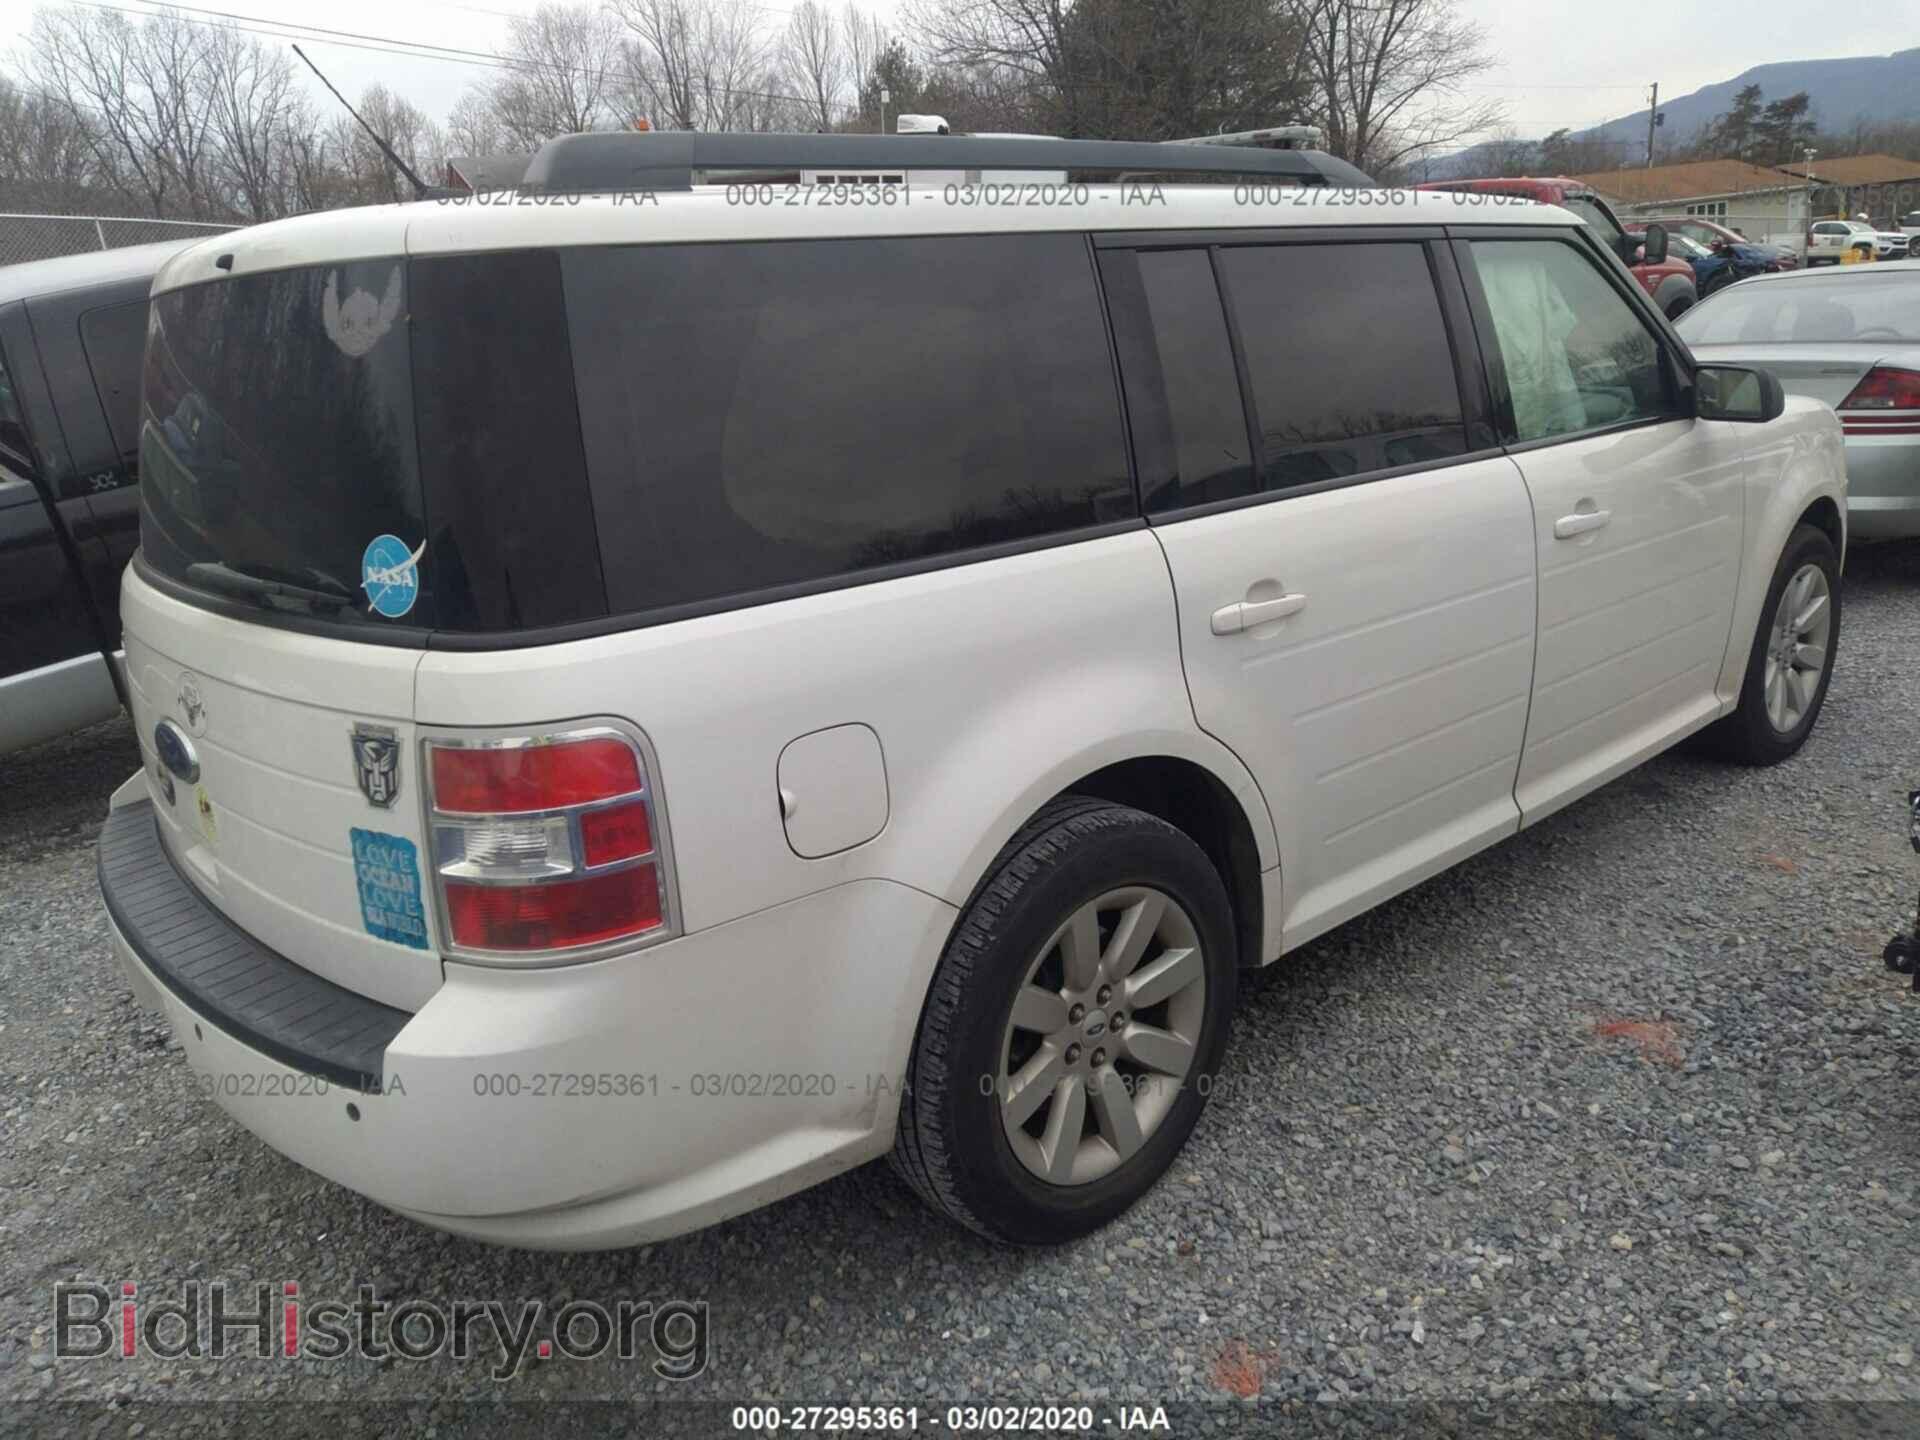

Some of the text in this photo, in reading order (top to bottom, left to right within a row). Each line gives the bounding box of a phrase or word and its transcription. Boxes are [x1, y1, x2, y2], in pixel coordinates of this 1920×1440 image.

[366, 565, 415, 587] NASA
[355, 839, 412, 874] LOVE
[362, 882, 417, 916] LOVE
